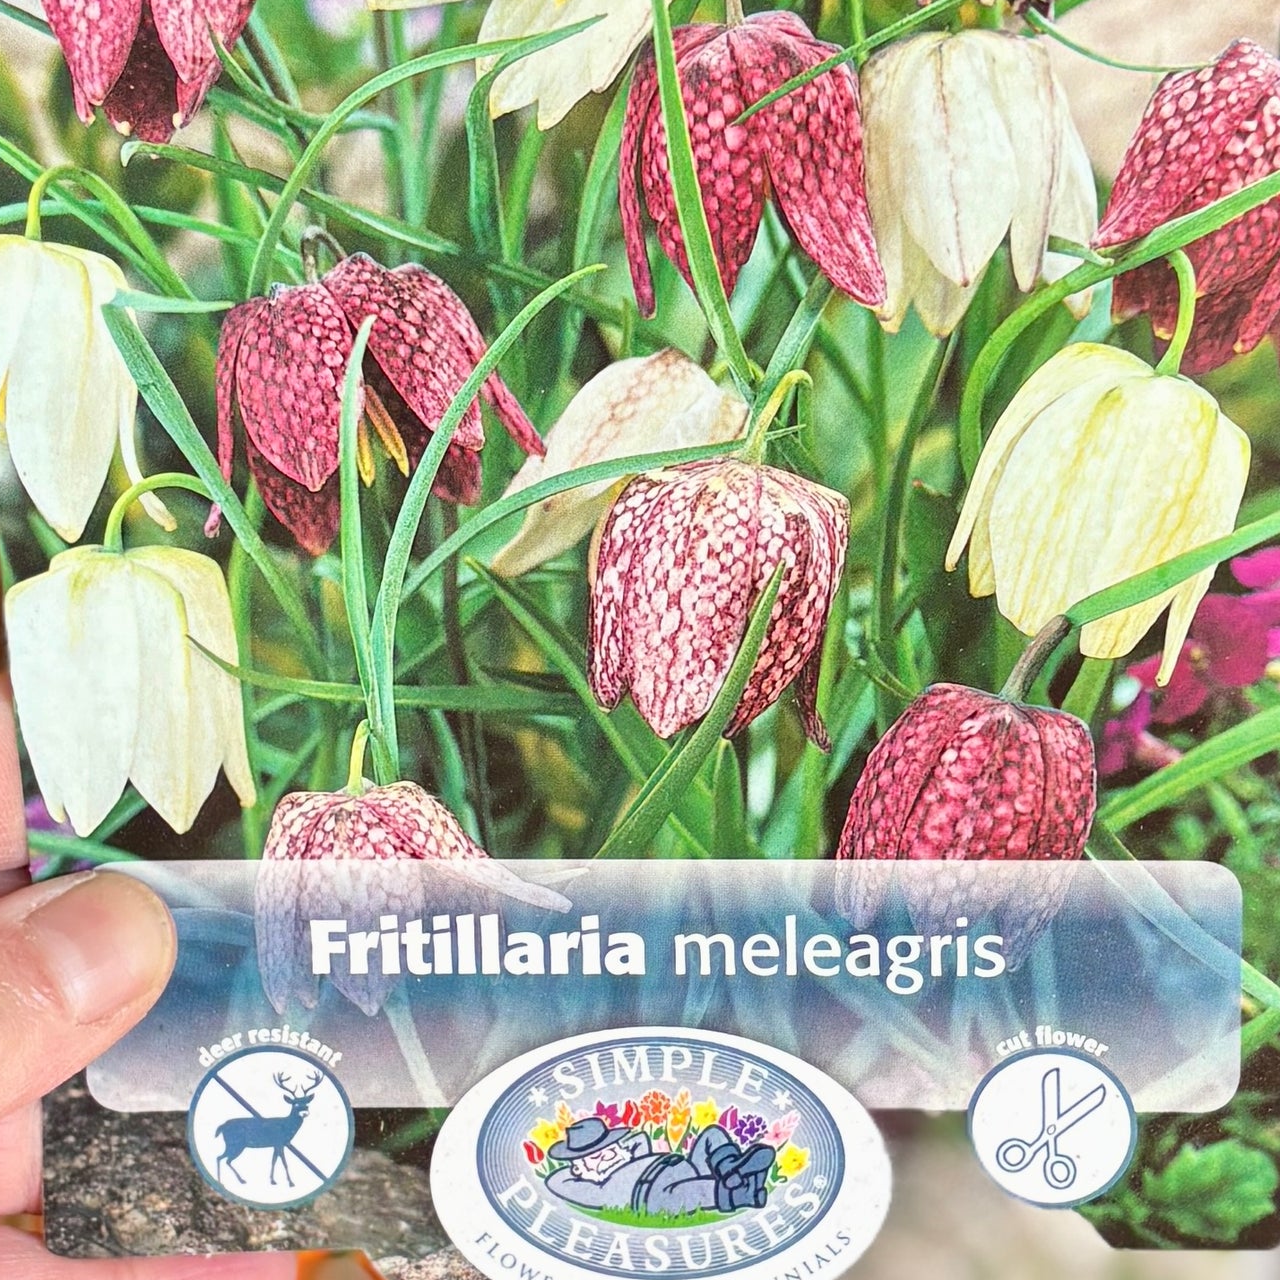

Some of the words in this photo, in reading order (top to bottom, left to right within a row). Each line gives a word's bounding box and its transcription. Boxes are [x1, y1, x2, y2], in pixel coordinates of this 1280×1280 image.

[309, 913, 646, 977] Fritillaria
[674, 914, 1007, 996] meleagris
[198, 1032, 243, 1067] deer
[248, 1024, 343, 1067] resistant
[995, 1030, 1032, 1057] cut
[1035, 1025, 1110, 1057] flower
[552, 1045, 770, 1104] SIMPLE
[496, 1175, 823, 1272] PLEASURES
